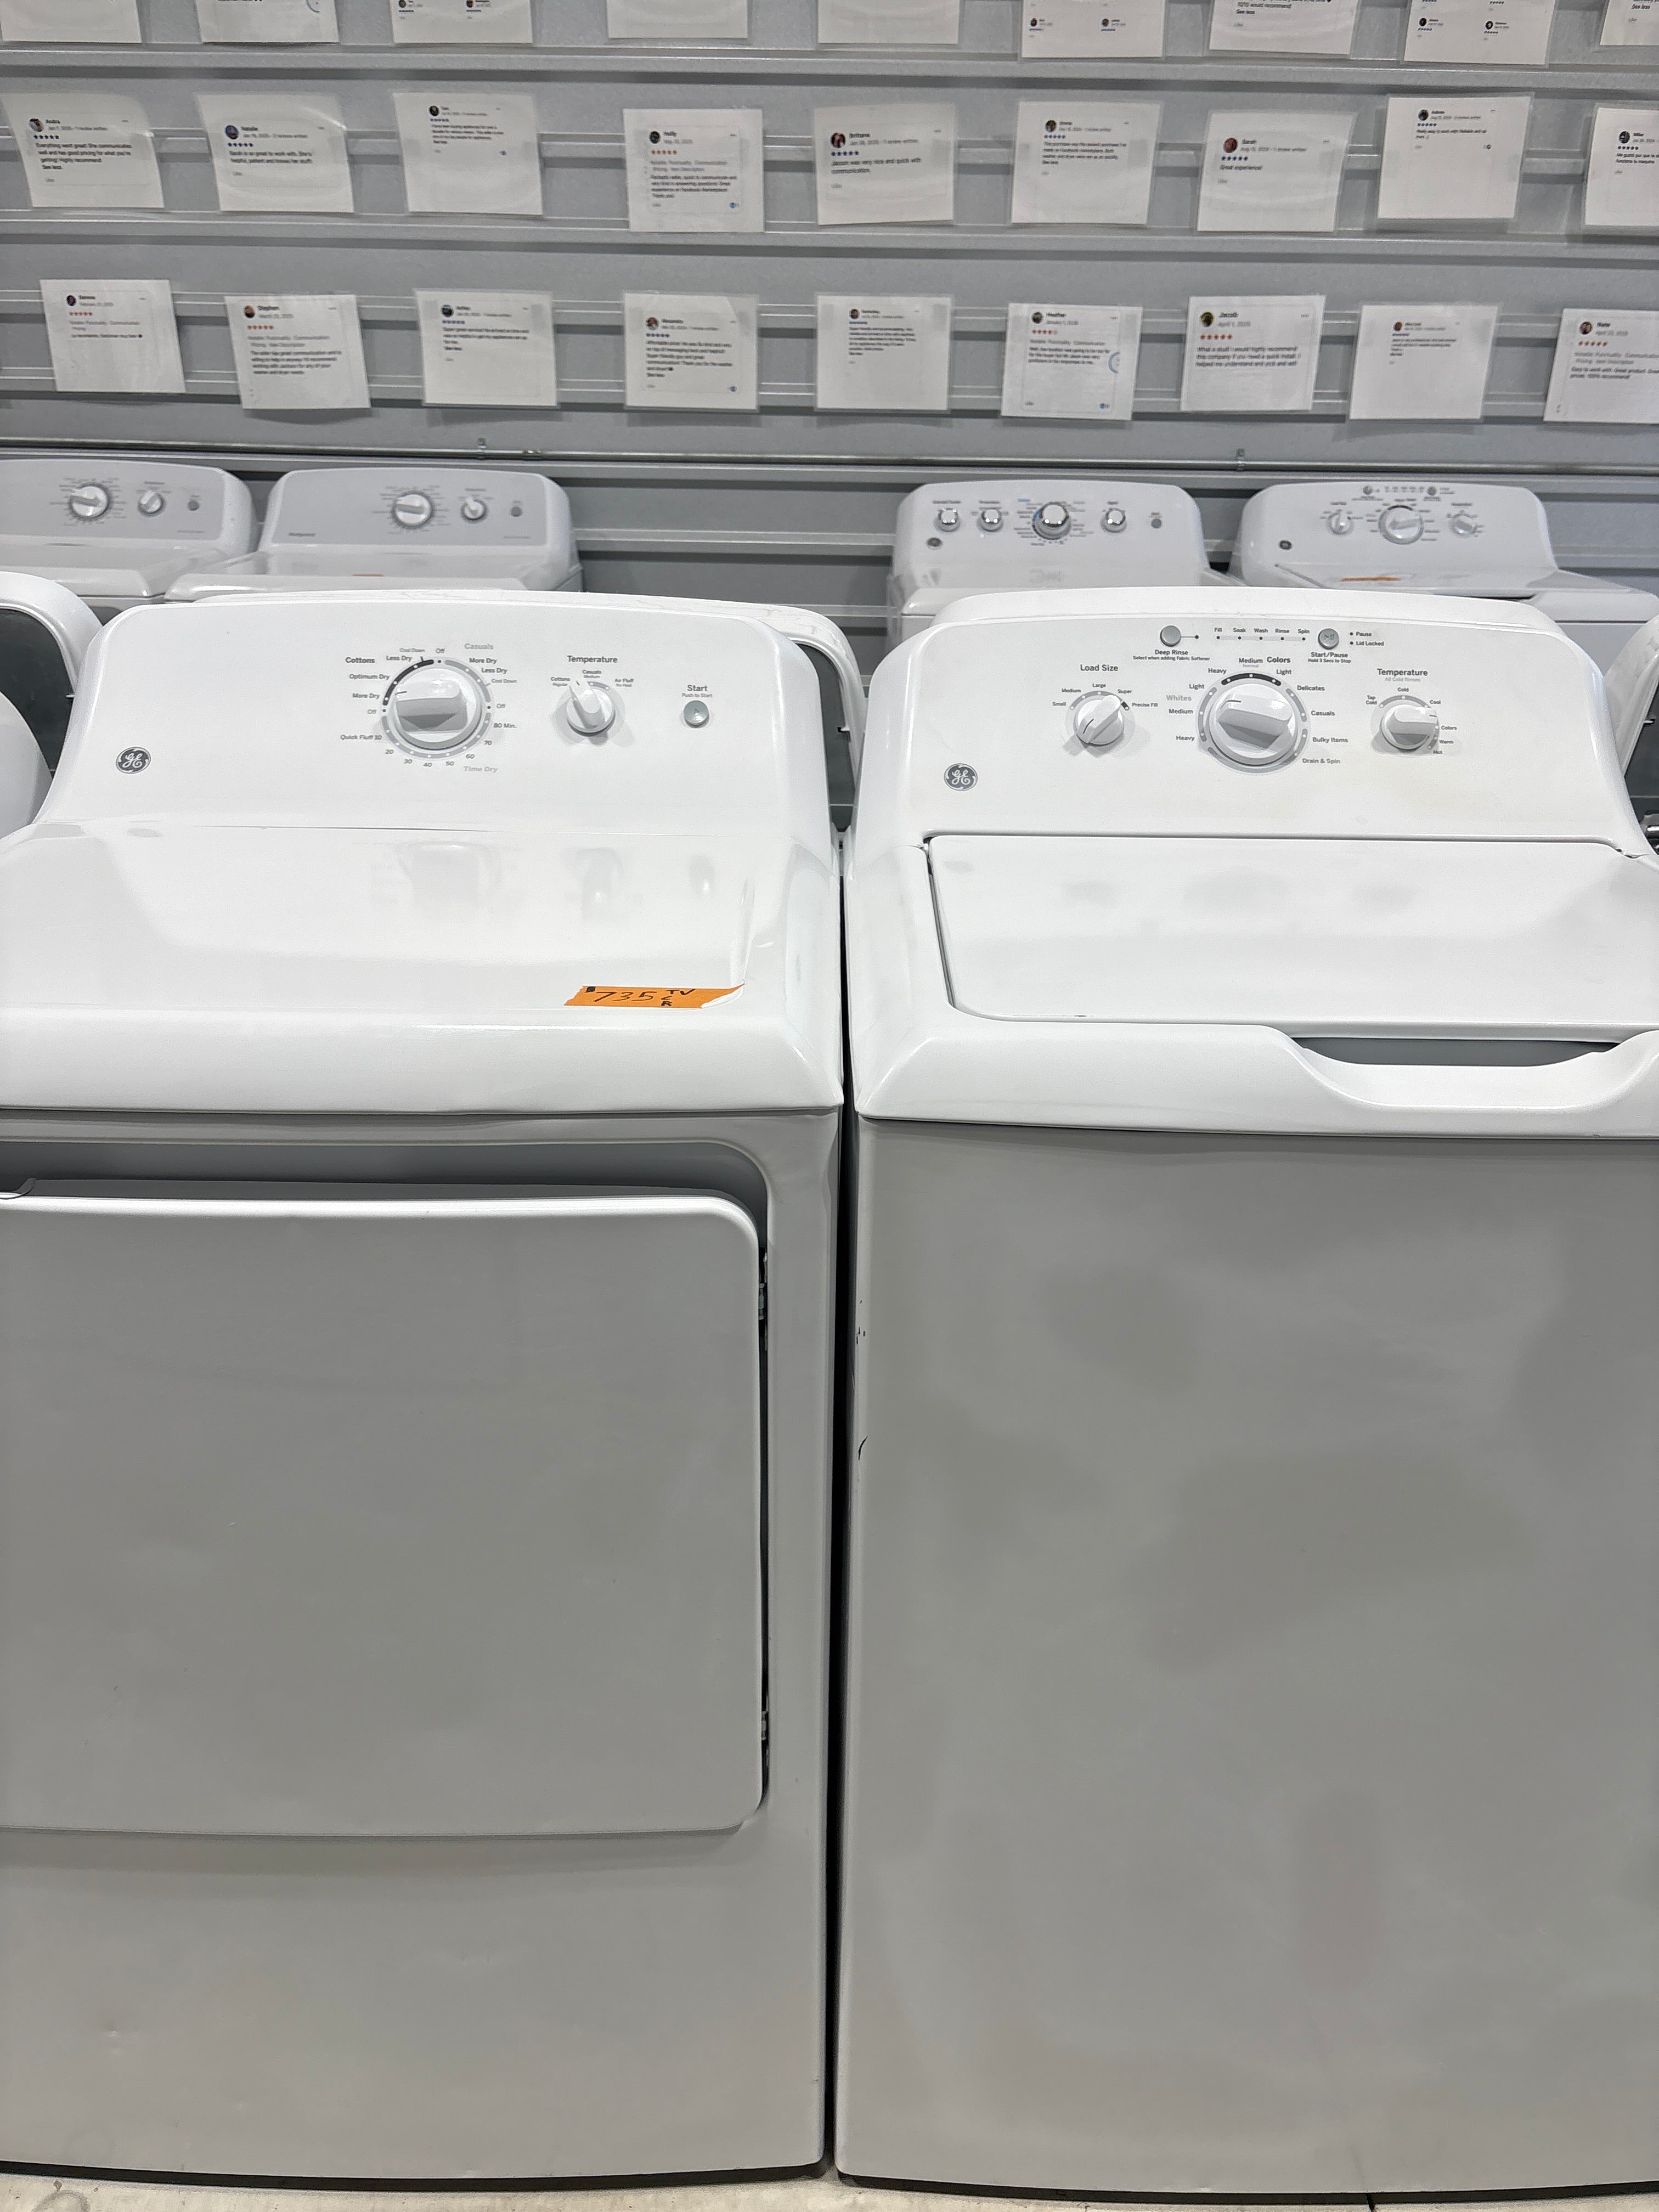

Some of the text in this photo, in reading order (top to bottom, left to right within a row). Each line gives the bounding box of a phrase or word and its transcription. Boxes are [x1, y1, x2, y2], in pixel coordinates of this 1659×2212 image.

[567, 655, 618, 663] Temperature
[1377, 668, 1428, 676] Temperature
[593, 991, 657, 1002] 735
